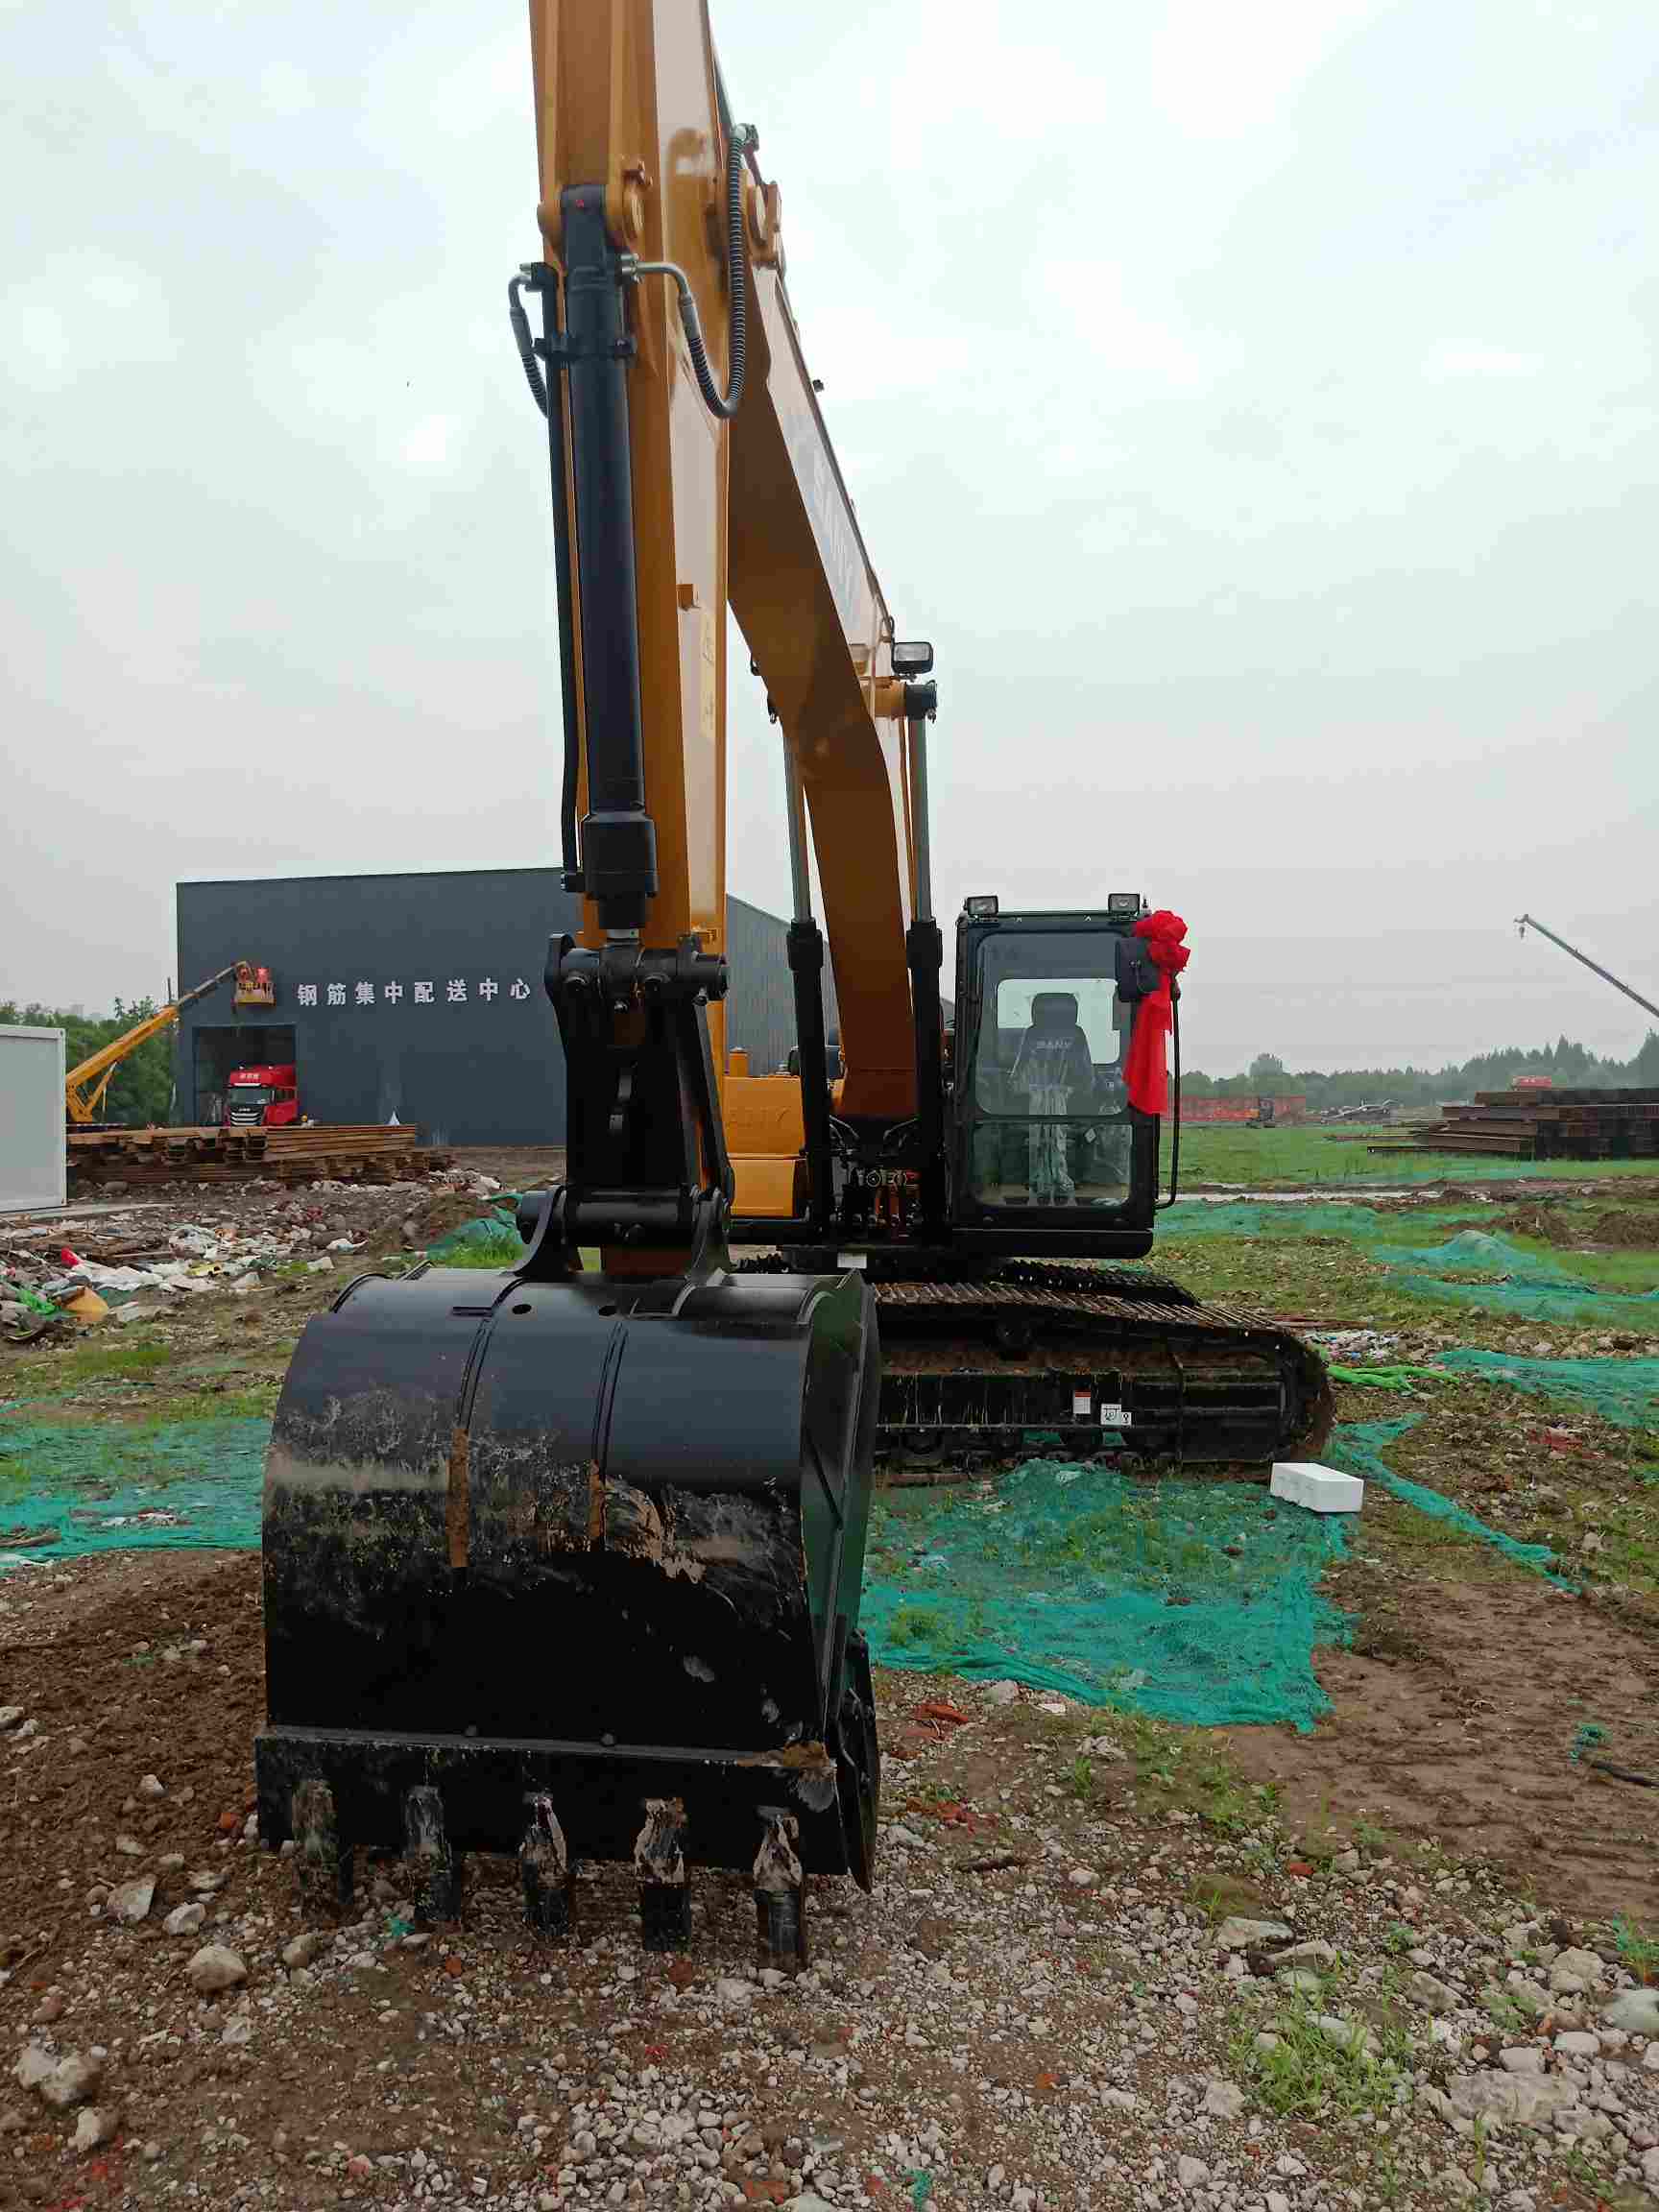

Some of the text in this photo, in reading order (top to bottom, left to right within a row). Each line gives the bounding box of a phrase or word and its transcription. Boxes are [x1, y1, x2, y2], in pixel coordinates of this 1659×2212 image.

[297, 977, 531, 1006] 钢筋集中配送中心
